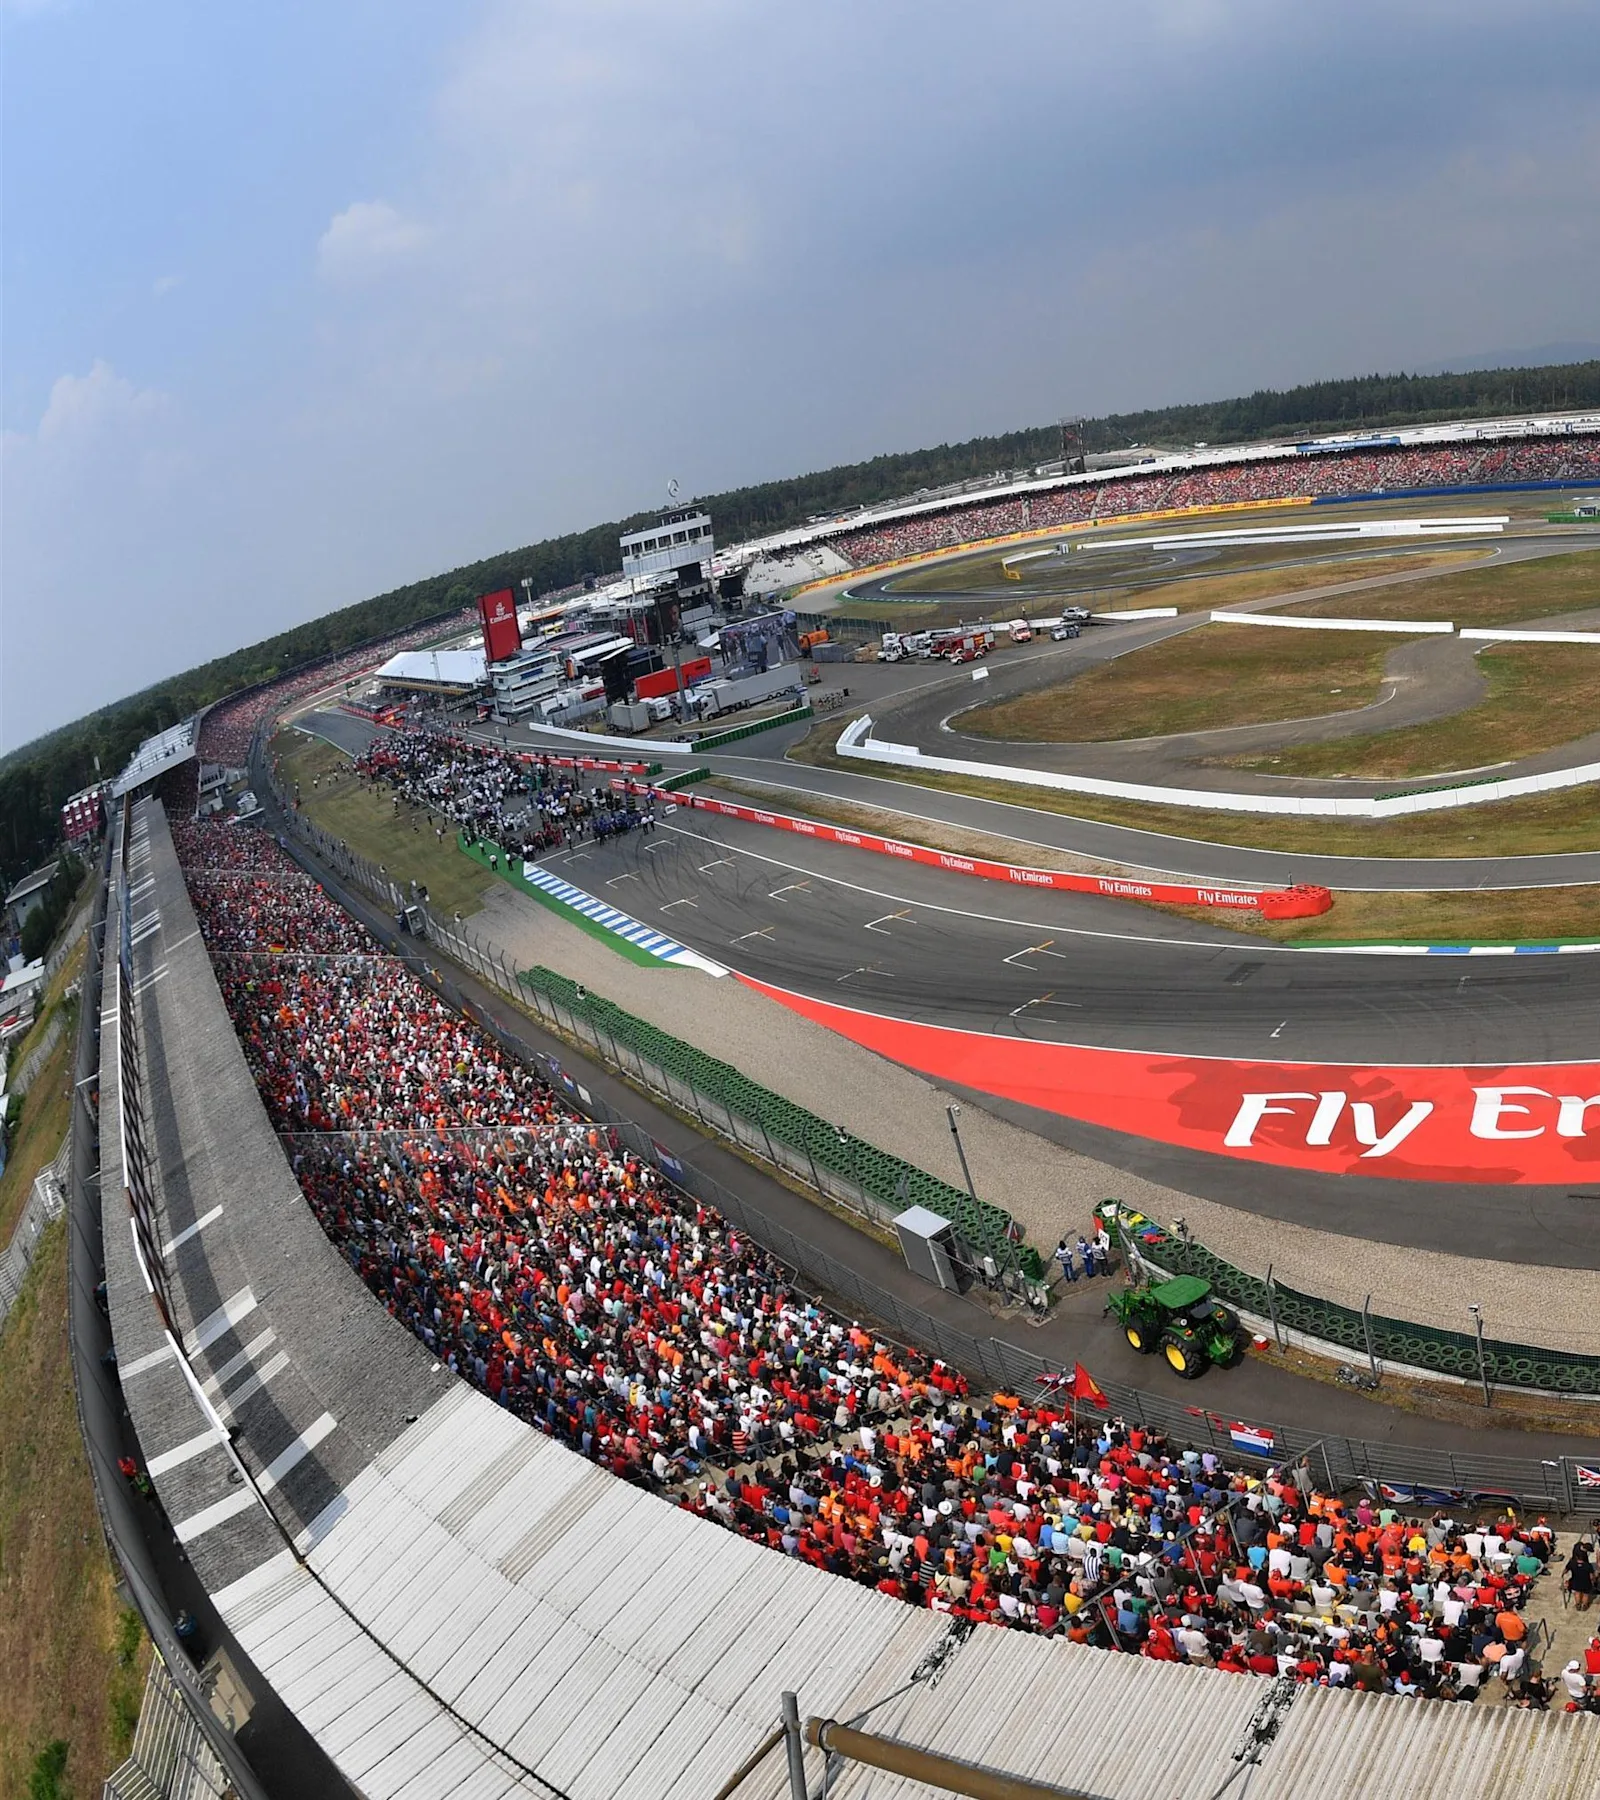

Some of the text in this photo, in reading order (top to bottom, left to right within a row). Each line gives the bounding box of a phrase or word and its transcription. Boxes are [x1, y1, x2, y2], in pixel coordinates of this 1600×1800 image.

[490, 612, 514, 624] Emirates
[666, 632, 682, 645] 12
[940, 856, 974, 871] Fly Emirates
[1010, 869, 1053, 884] Fly Emirates
[1099, 880, 1152, 896] Fly Emirates
[1197, 890, 1258, 905] Fly Emirates
[1224, 1091, 1433, 1158] Fly
